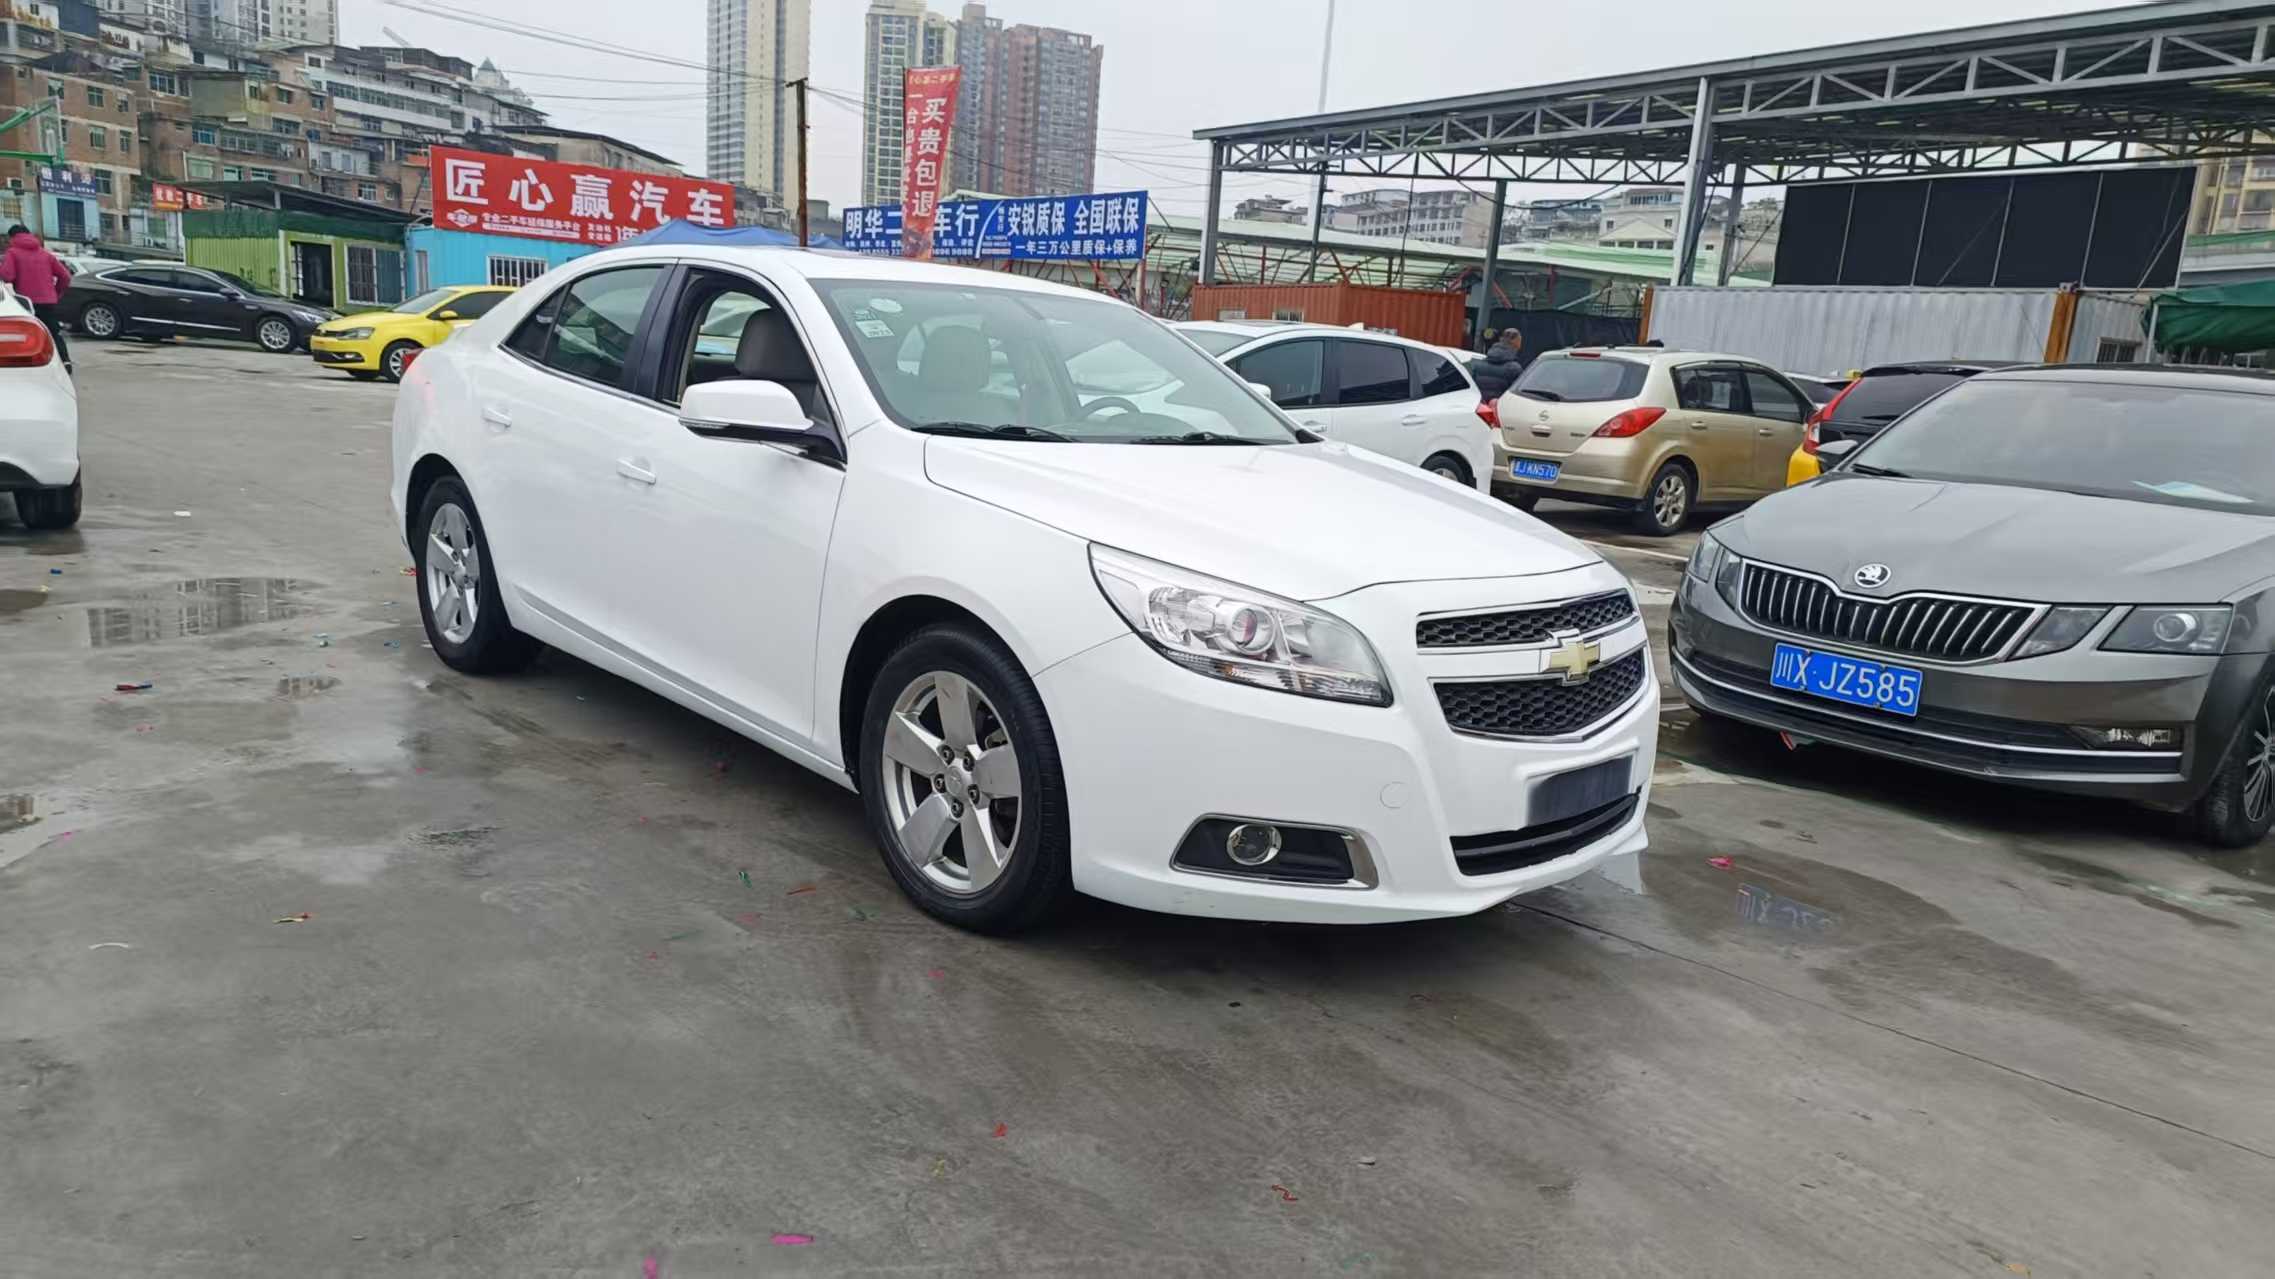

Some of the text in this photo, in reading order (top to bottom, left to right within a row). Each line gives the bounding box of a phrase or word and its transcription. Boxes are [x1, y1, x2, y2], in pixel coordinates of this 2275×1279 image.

[912, 98, 947, 218] 买贵包退
[445, 157, 724, 227] 匠心赢汽车
[846, 204, 979, 239] 明华二车行
[1008, 201, 1066, 236] 安锐质保
[1074, 197, 1140, 235] 全国联保
[1016, 239, 1137, 255] 一年三万公里质保+保养
